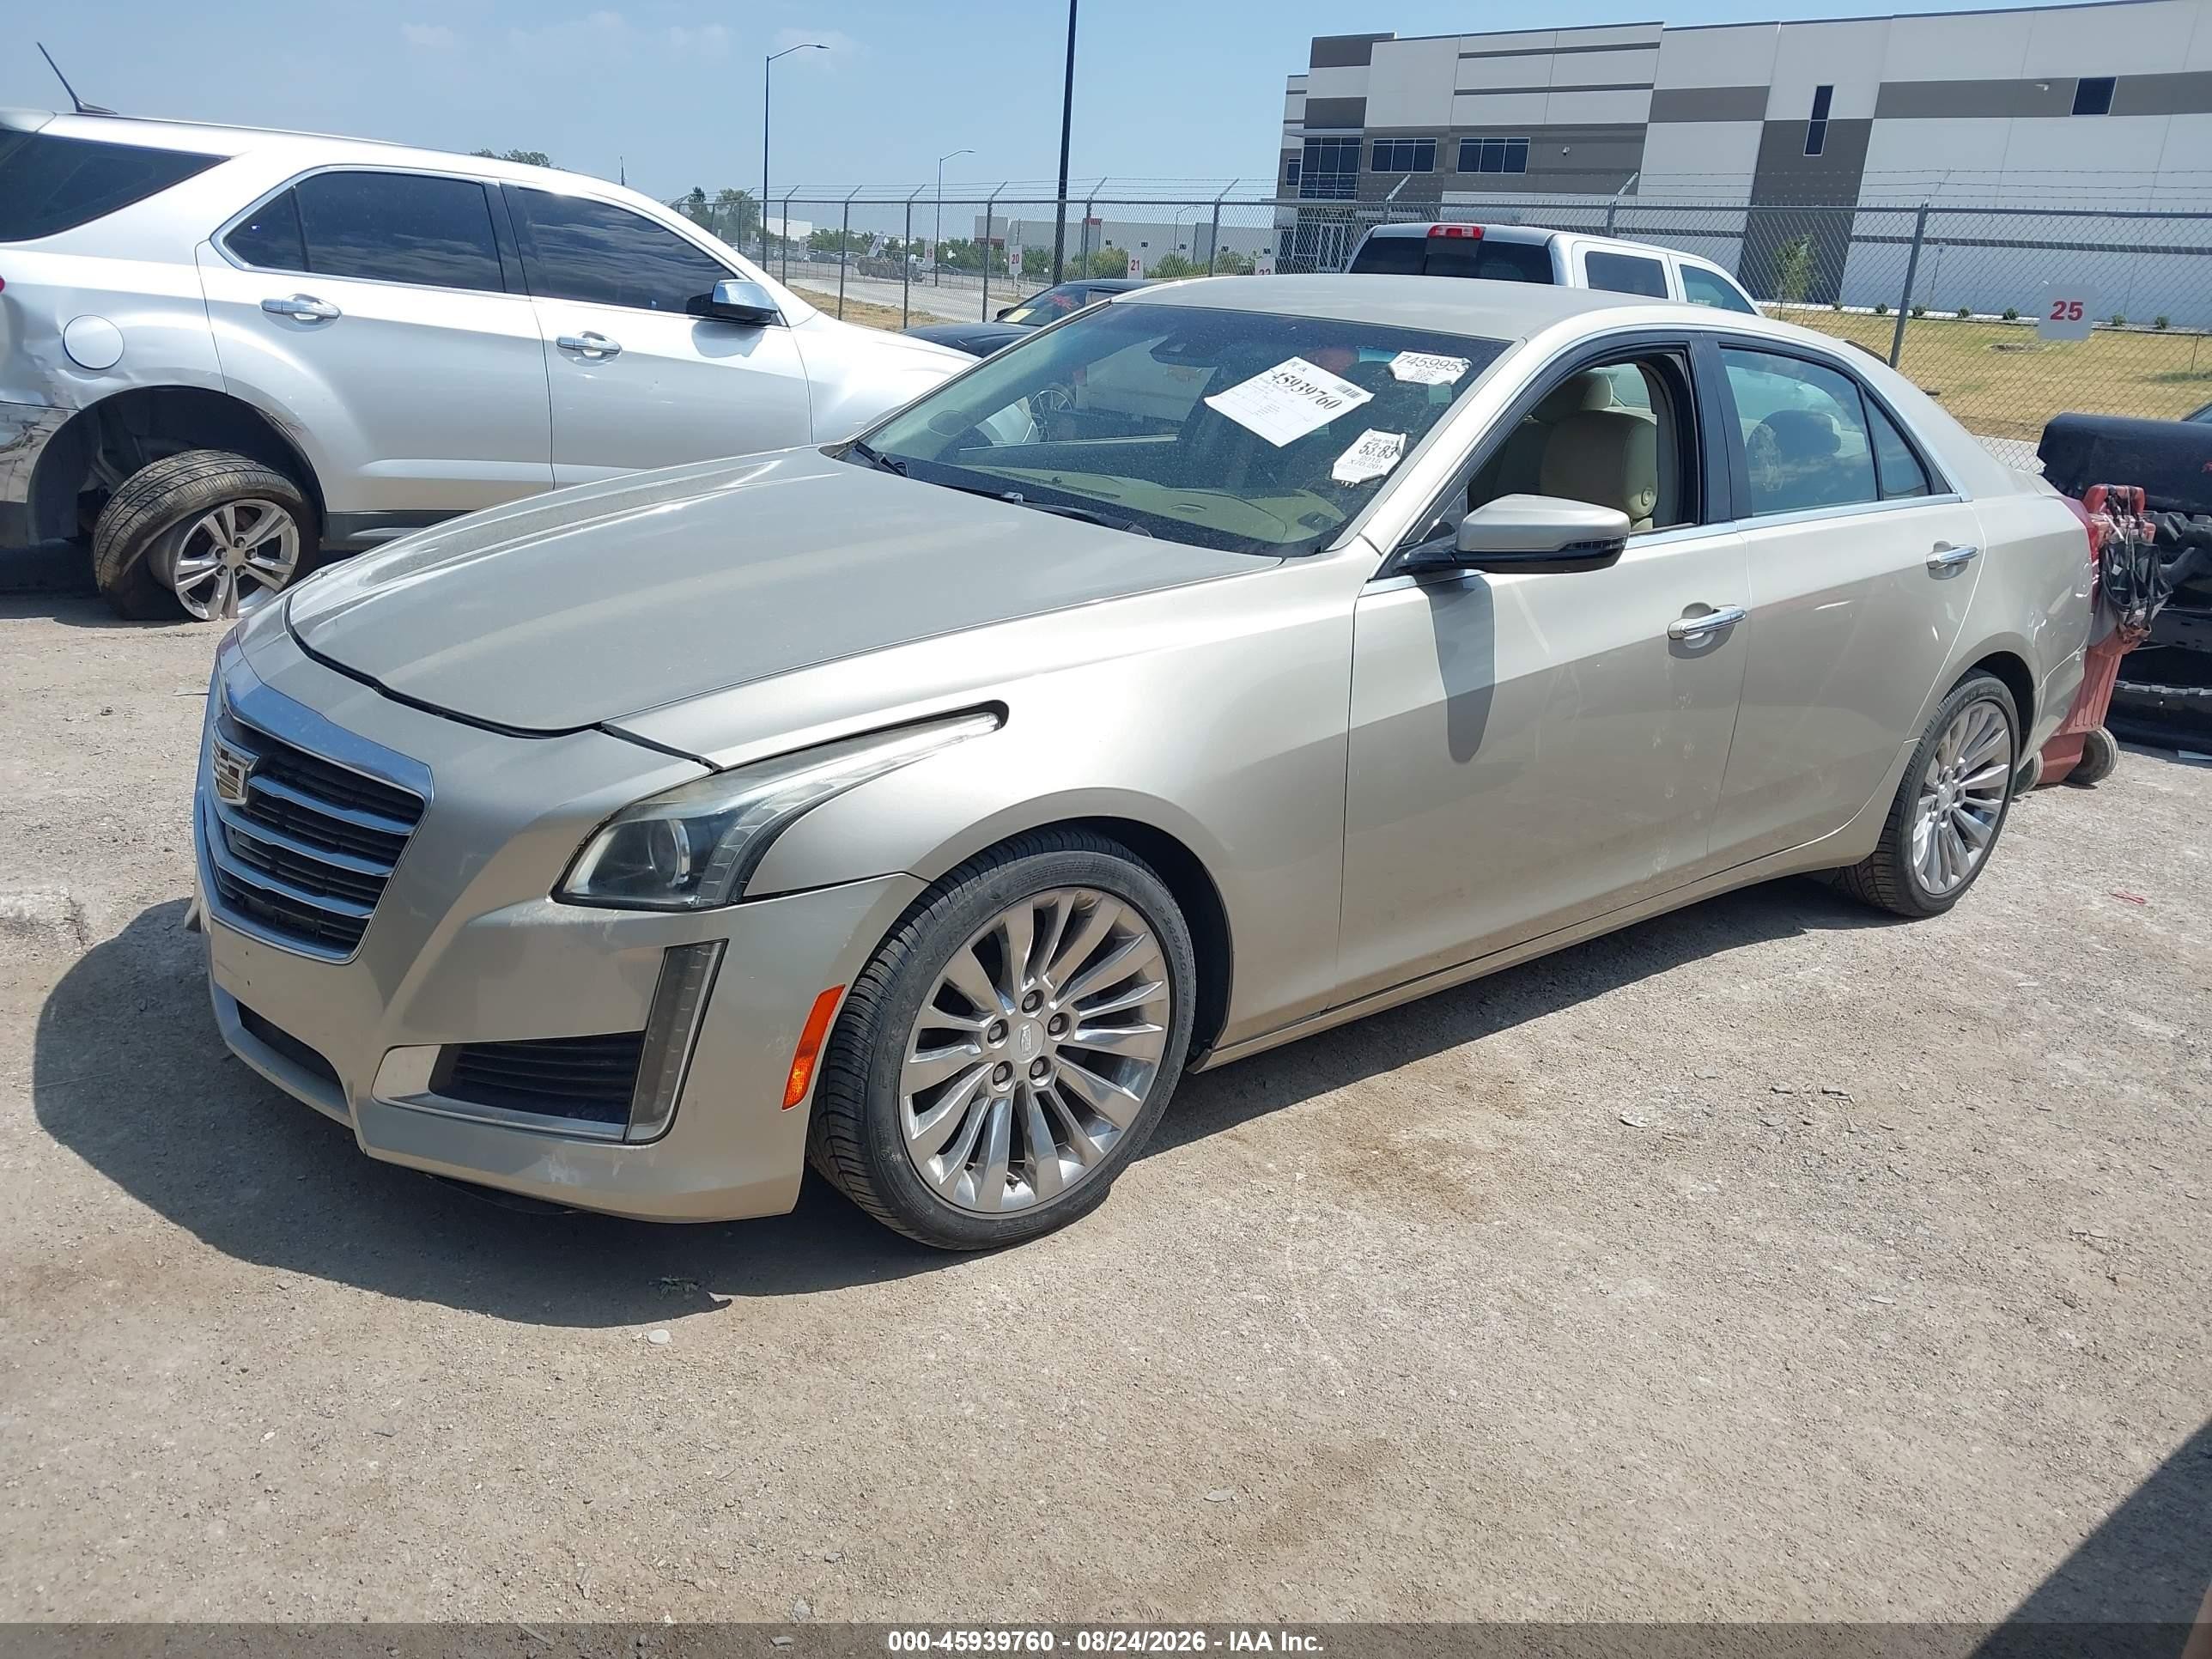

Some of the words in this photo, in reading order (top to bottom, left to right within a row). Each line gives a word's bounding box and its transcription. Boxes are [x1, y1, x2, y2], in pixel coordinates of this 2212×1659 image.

[1011, 253, 1020, 264] 20
[1130, 259, 1140, 271] 21
[2050, 301, 2084, 321] 25
[1272, 372, 1343, 410] 45939760
